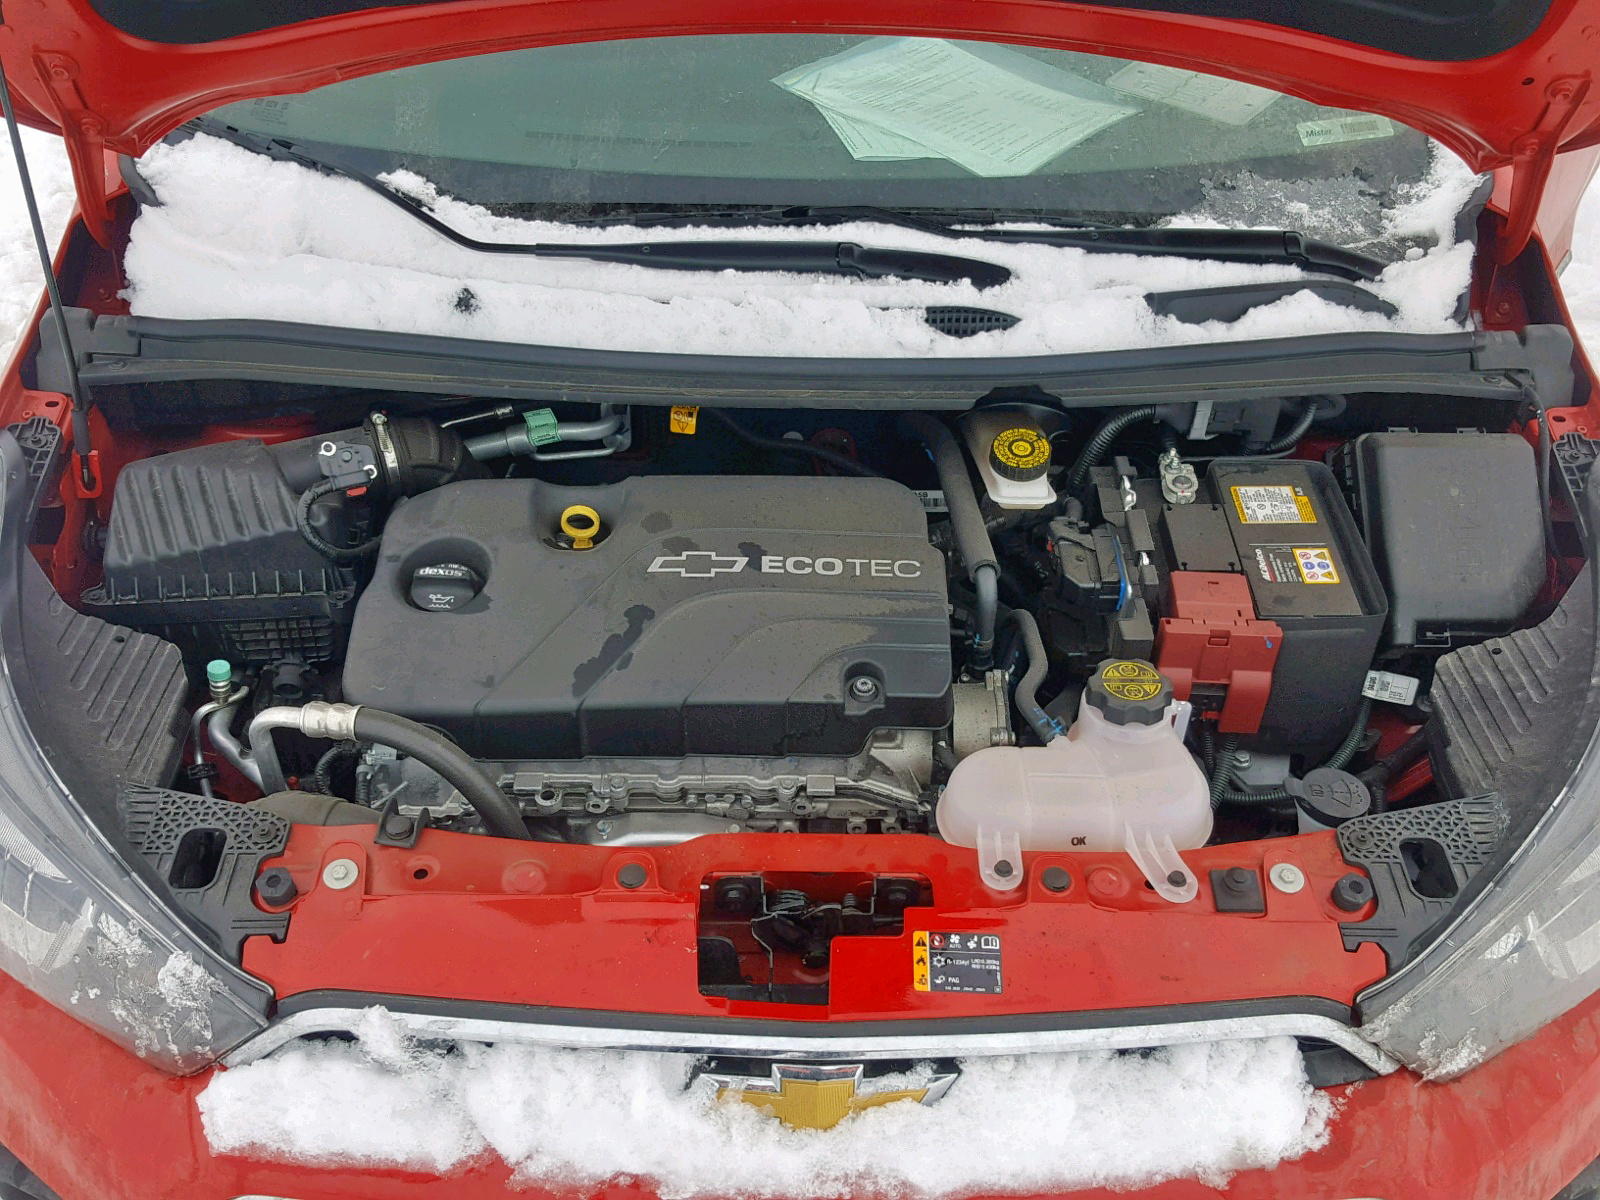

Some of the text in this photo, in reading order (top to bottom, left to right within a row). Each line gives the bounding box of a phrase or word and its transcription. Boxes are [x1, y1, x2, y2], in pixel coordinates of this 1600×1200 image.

[761, 555, 921, 577] ECOTEC
[1071, 836, 1086, 846] OK
[948, 976, 960, 984] PAG
